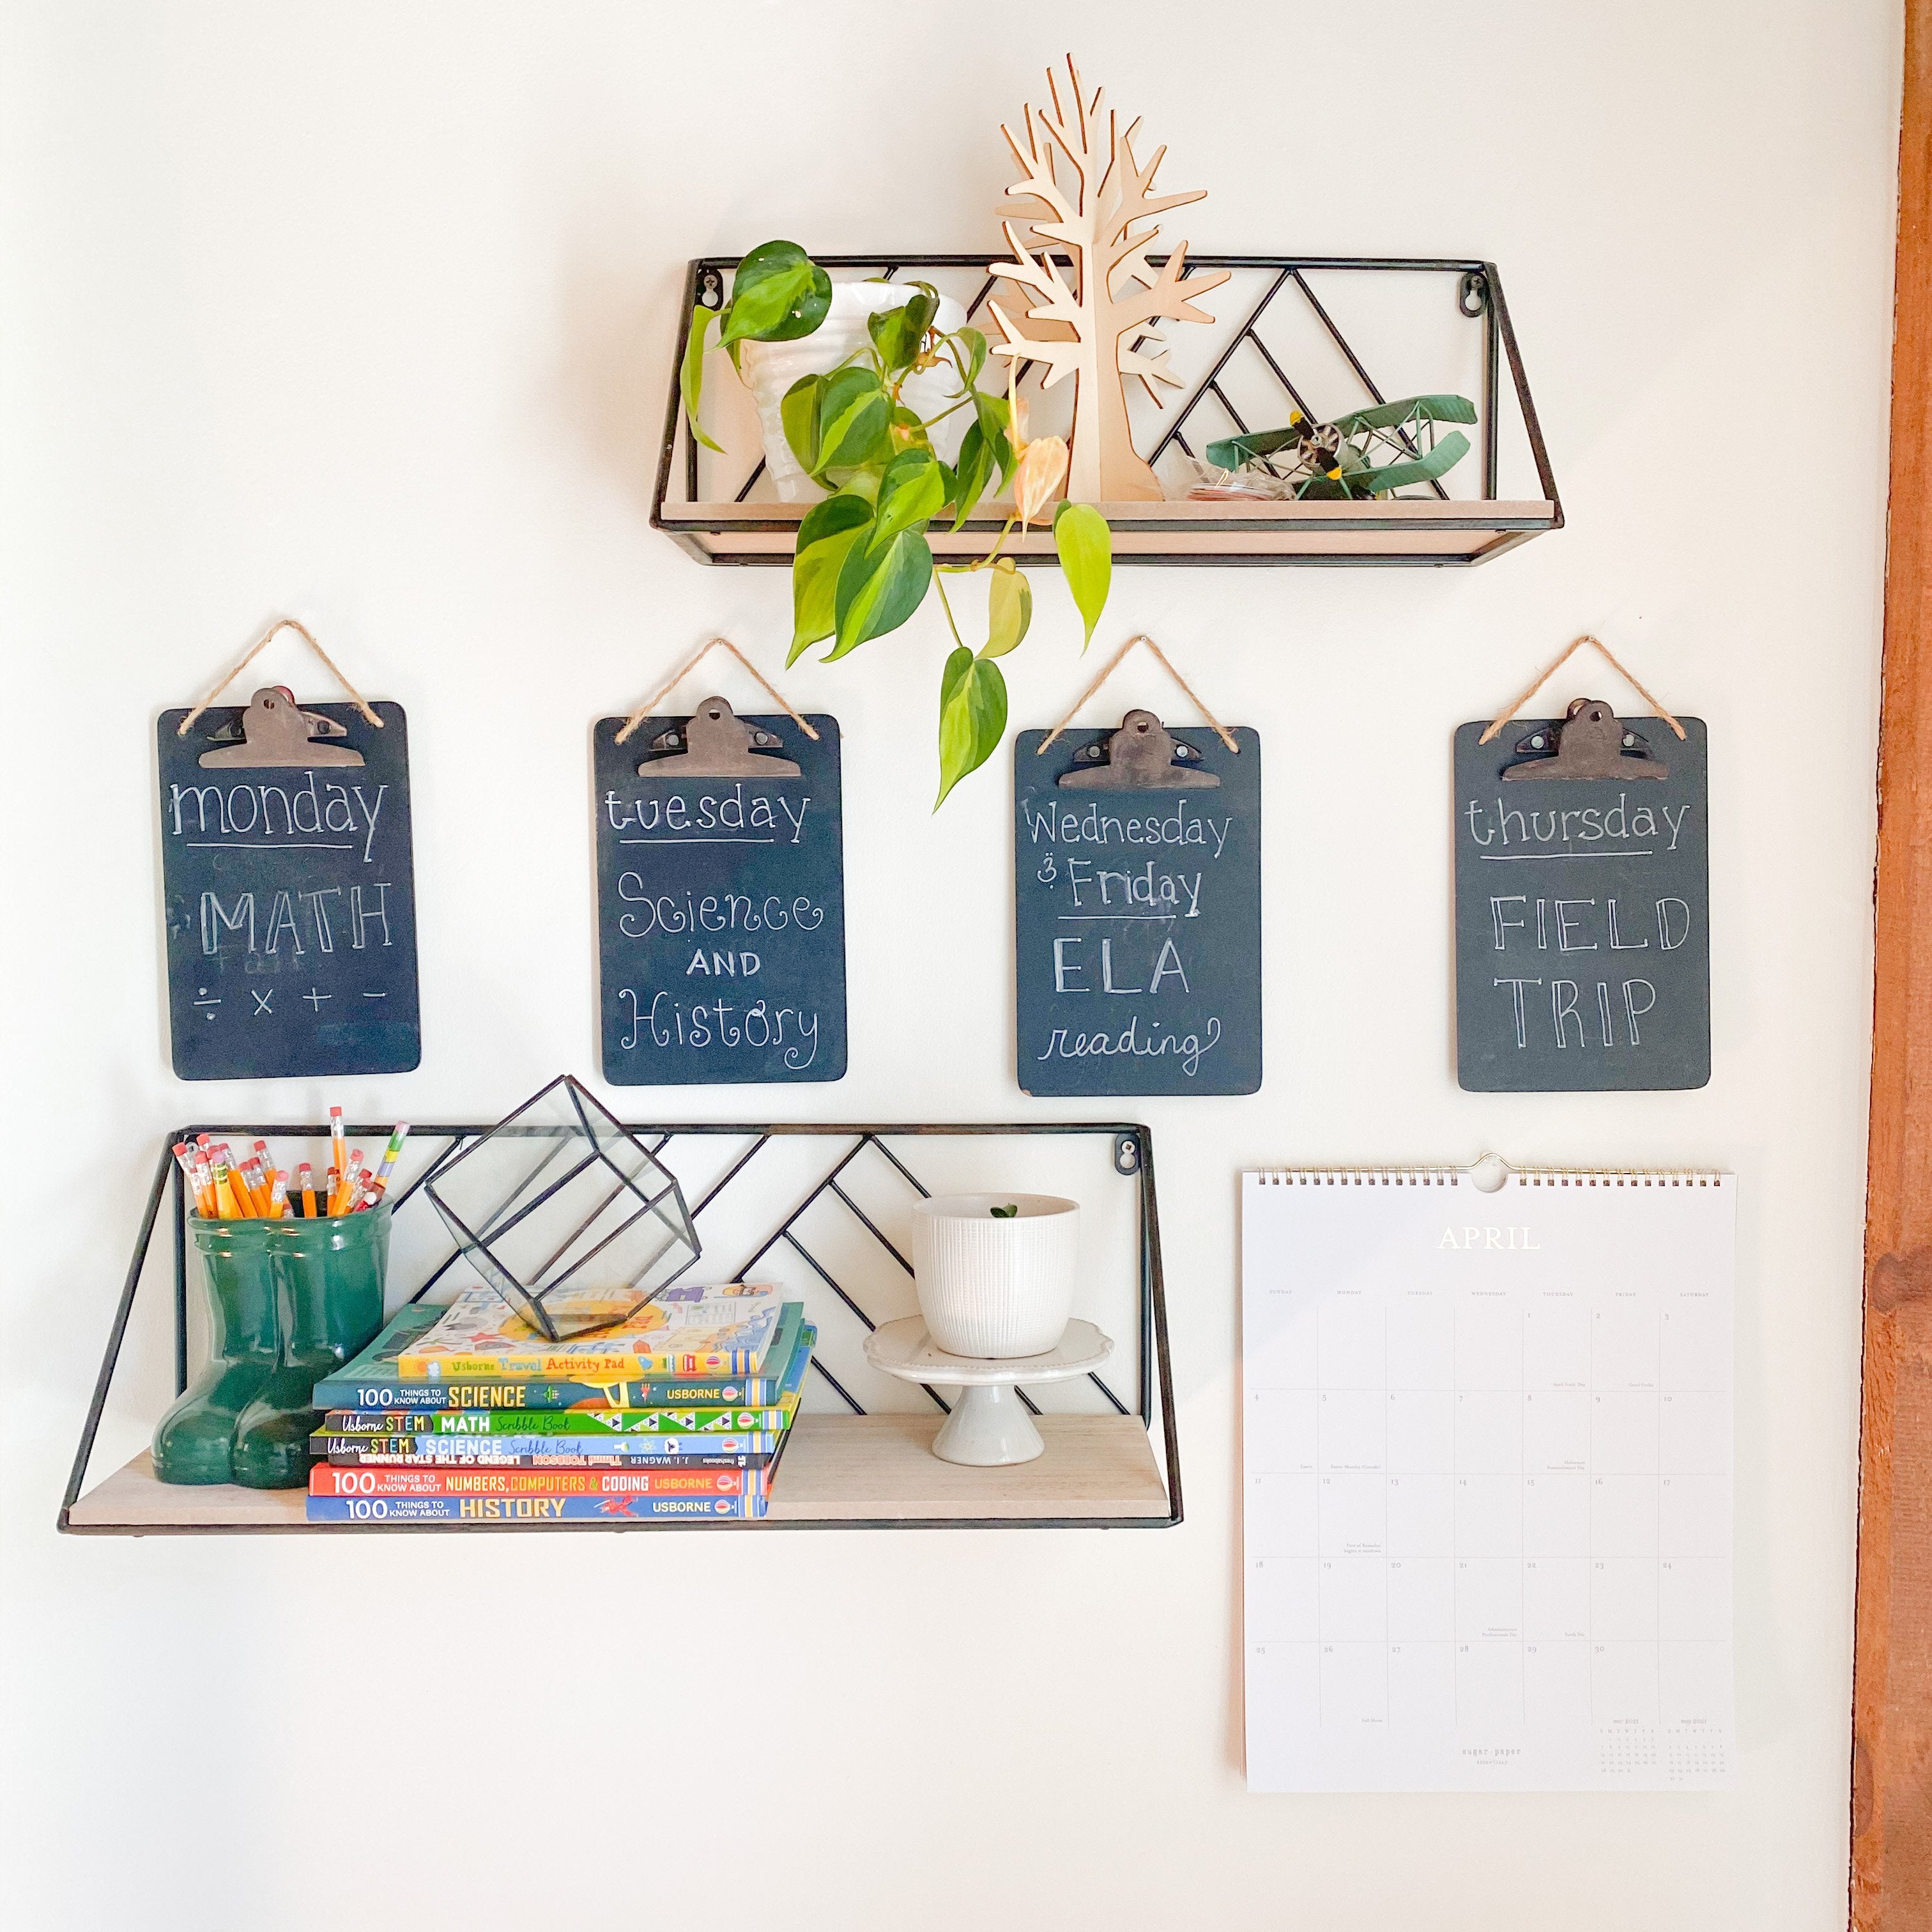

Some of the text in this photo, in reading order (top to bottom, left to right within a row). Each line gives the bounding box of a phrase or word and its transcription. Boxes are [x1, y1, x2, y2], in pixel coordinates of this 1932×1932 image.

[169, 771, 388, 863] monday
[605, 783, 811, 843] tuesday
[1464, 793, 1690, 850] thursday
[1021, 799, 1234, 859] Wednesday
[1068, 858, 1202, 917] Friday
[618, 871, 824, 937] Science
[200, 883, 392, 955] MATH
[1490, 896, 1690, 951] FIELD
[686, 949, 760, 977] AND
[1054, 937, 1190, 994] ELA
[1493, 978, 1657, 1049] TRIP
[618, 988, 818, 1070] History
[1436, 1227, 1542, 1250] APRIL
[452, 1358, 624, 1372] Usborne Travel Activity Pad
[357, 1388, 392, 1406] 100
[448, 1386, 526, 1407] SCIENCE
[666, 1389, 720, 1399] USBORNE
[342, 1414, 571, 1432] Usborne STEM MATH Scribble Book
[327, 1438, 583, 1455] Usborne STEM SCIENCE Scribble Book
[359, 1455, 520, 1465] LEGEND OF THE STAR RUNNER
[631, 1456, 671, 1464] WAGNER
[332, 1473, 376, 1493] 100
[446, 1476, 649, 1493] NUMBERS, COMPUTERS & CODING
[654, 1478, 713, 1489] USBORNE
[346, 1500, 388, 1519] 100
[460, 1498, 566, 1518] HISTORY
[652, 1501, 711, 1513] USBORNE
